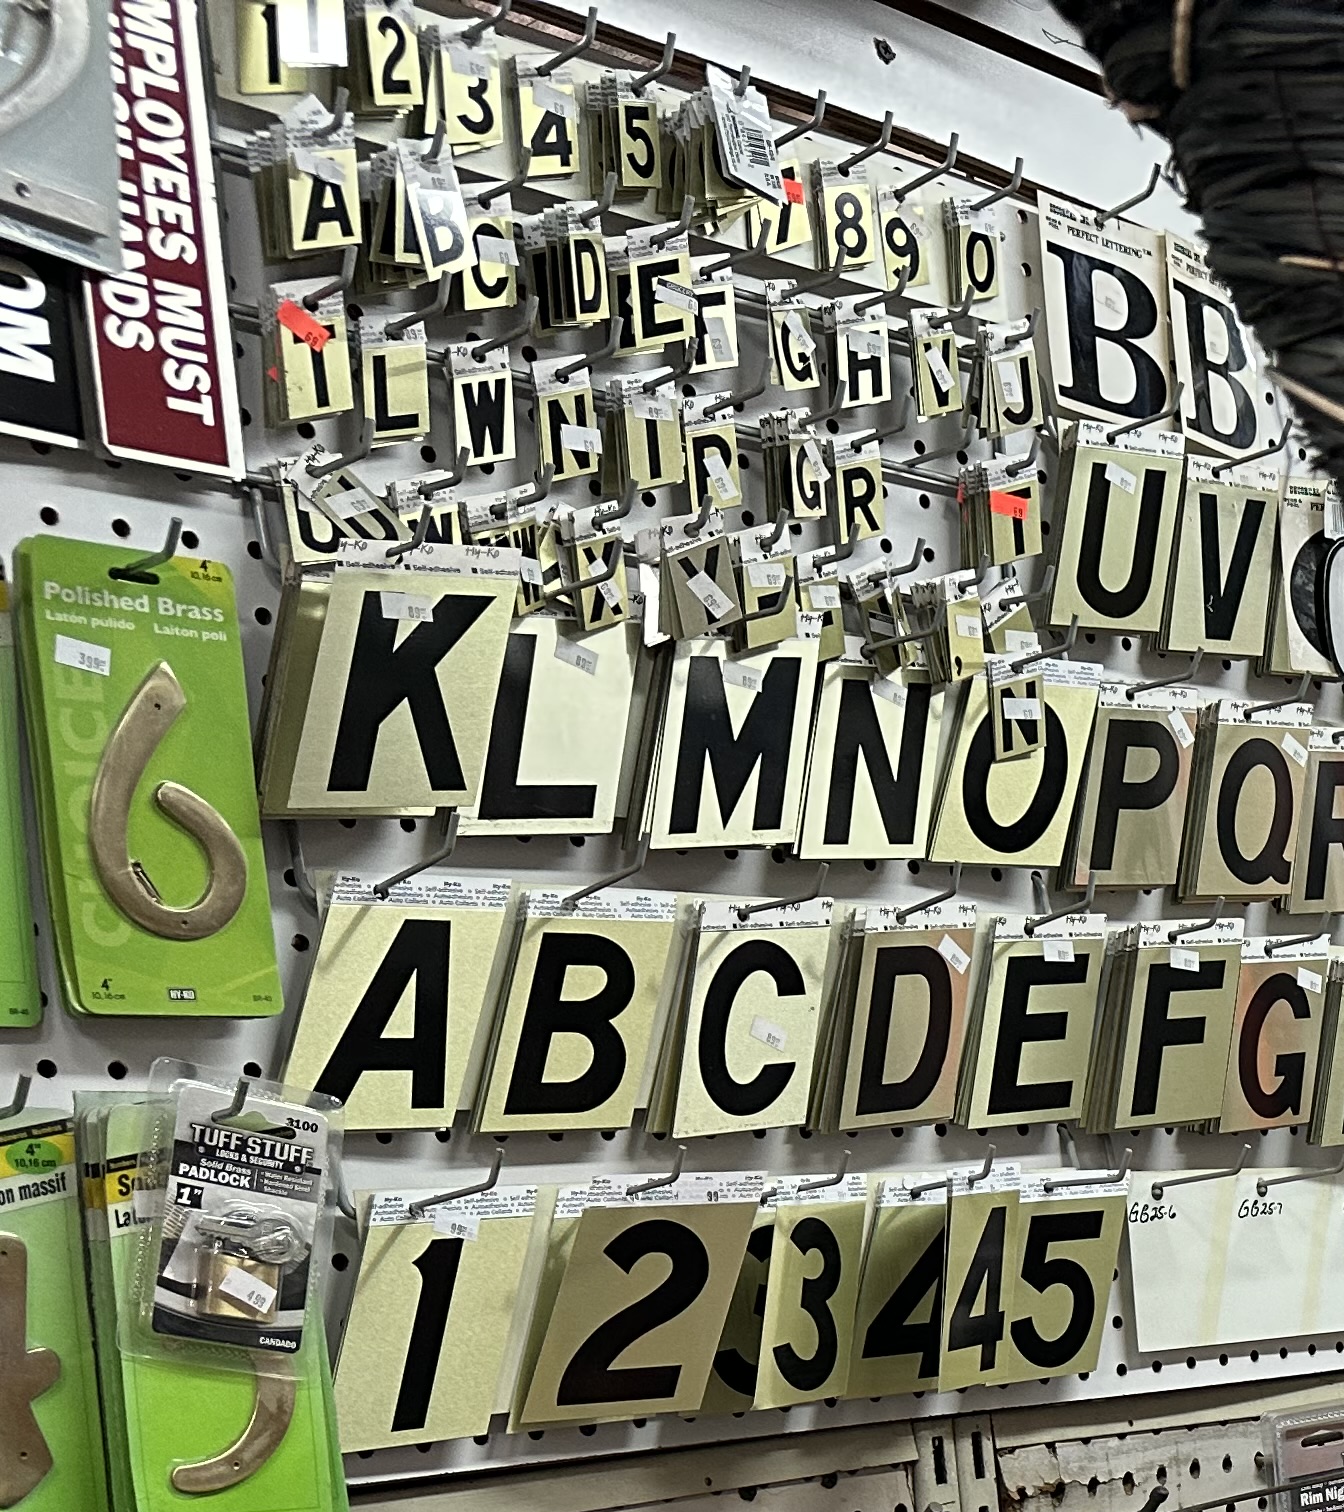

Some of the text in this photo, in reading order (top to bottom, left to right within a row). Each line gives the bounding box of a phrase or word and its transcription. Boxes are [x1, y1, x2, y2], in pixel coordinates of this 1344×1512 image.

[261, 4, 282, 85] 1
[378, 16, 411, 97] 2
[625, 106, 655, 180] 5
[422, 193, 465, 267] B
[578, 236, 604, 314] D
[635, 259, 685, 339] E
[836, 193, 867, 258] 8
[885, 217, 920, 289] 9
[154, 279, 215, 426] MUST
[375, 354, 421, 433] L
[1048, 242, 1167, 419] B
[1173, 278, 1257, 448] B
[464, 380, 509, 458] W
[844, 466, 877, 538] R
[1078, 464, 1165, 619] U
[1201, 493, 1266, 641] V
[42, 581, 224, 623] Polished Brass
[90, 614, 135, 632] pulido
[154, 622, 195, 641] Laiton
[201, 627, 227, 642] poli
[327, 591, 498, 793] K
[478, 633, 598, 821] L
[669, 656, 802, 834] M
[823, 679, 932, 845] N
[1092, 719, 1178, 871] P
[1216, 738, 1294, 886] Q
[313, 919, 452, 1110] A
[504, 932, 635, 1116] B
[700, 939, 806, 1117] C
[857, 945, 953, 1116] D
[988, 953, 1089, 1116] E
[1131, 959, 1226, 1116] F
[1239, 972, 1312, 1121] G
[179, 1162, 251, 1188] PADLOCK
[191, 1124, 314, 1164] TUFF STUFF
[216, 1149, 284, 1169] LOCKS SECURITY
[286, 1117, 318, 1133] 3100
[259, 1336, 296, 1349] CANDADO
[391, 1237, 465, 1433] 1
[557, 1219, 710, 1407] 2
[772, 1217, 842, 1391] 3
[948, 1207, 1006, 1371] 4
[1010, 1209, 1104, 1369] 5
[1301, 1491, 1323, 1506] Rim
